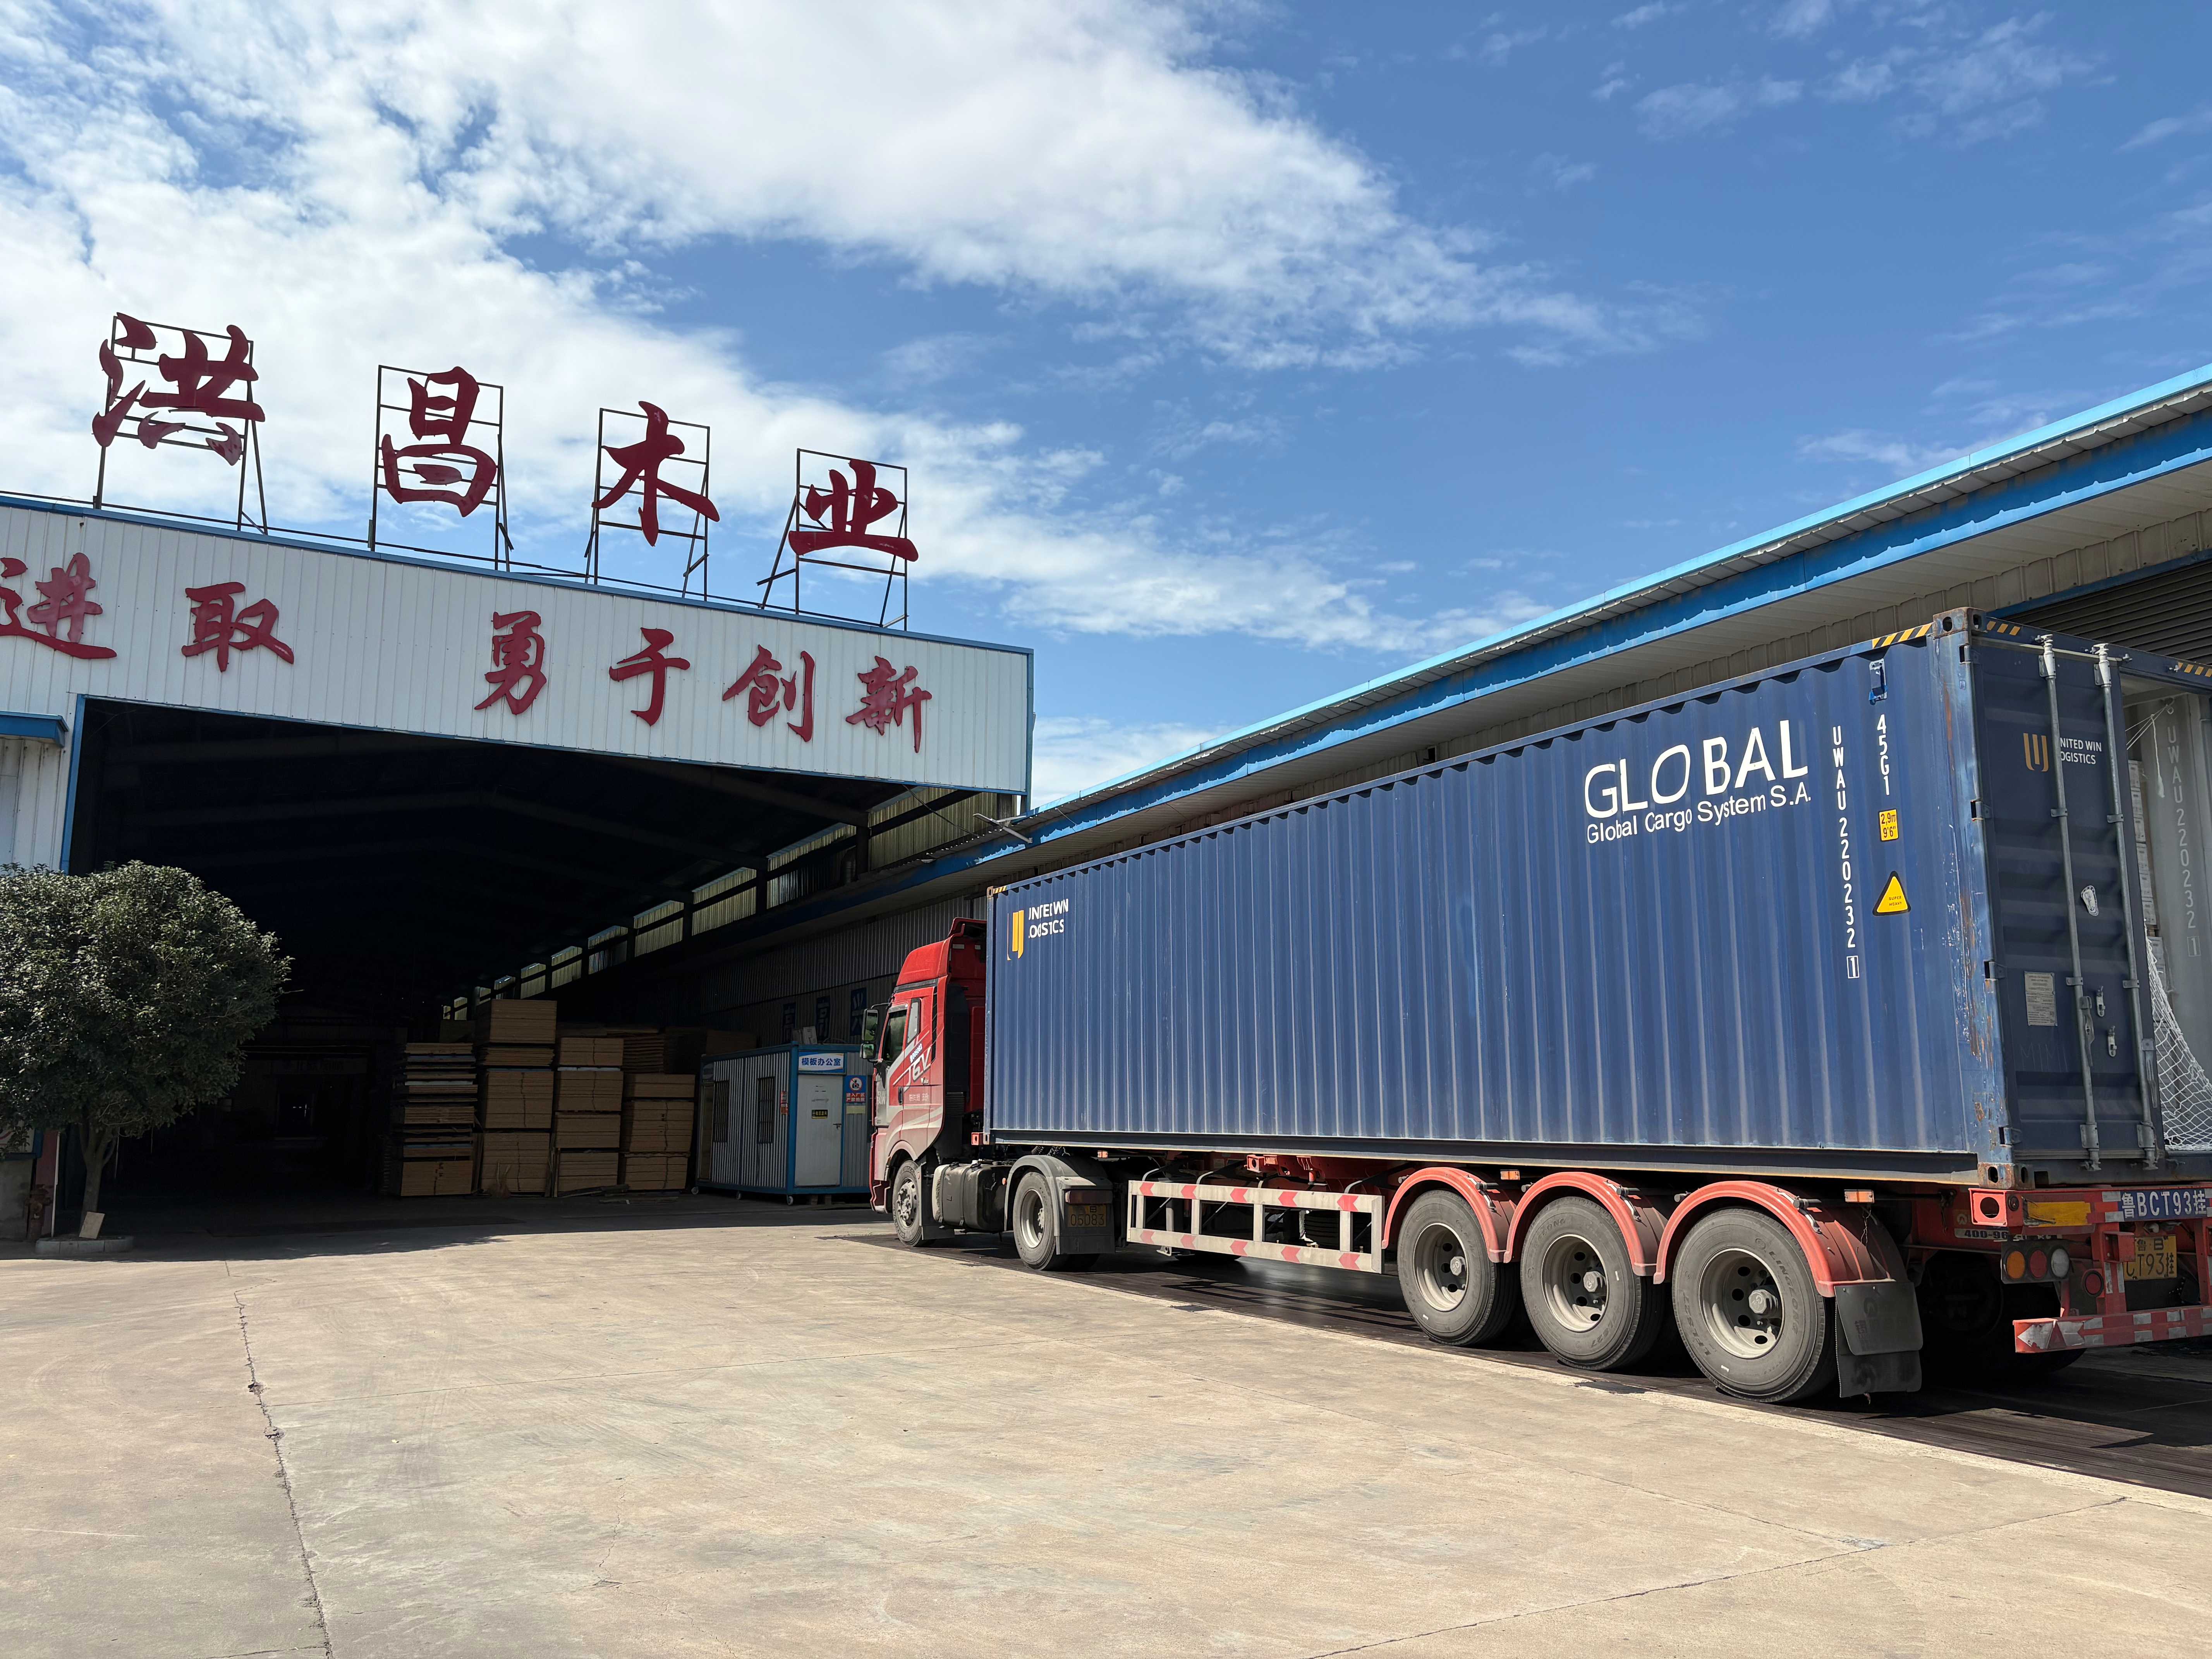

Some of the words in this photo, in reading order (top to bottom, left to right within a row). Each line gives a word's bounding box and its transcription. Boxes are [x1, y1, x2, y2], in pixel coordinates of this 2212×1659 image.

[92, 313, 919, 562] 洪昌木业
[1585, 720, 1808, 818] GLOBAL
[1833, 726, 1846, 811] UWAU
[1877, 714, 1890, 795] 45G1
[2060, 737, 2084, 750] NITED
[2085, 740, 2102, 752] WIN
[2060, 751, 2096, 765] OGISTICS
[1587, 816, 1637, 844] Global
[1645, 809, 1692, 832] Cargo
[1697, 794, 1766, 826] System
[1770, 782, 1812, 808] S.A.
[1881, 813, 1896, 825] 2,9m
[2167, 726, 2183, 804] UWAU
[2176, 809, 2196, 929] 220232
[1839, 817, 1856, 948] 220232
[802, 1058, 841, 1066] 模板办公室
[1070, 1214, 1104, 1226] 05083
[2121, 1190, 2207, 1219] 鲁BCT93挂
